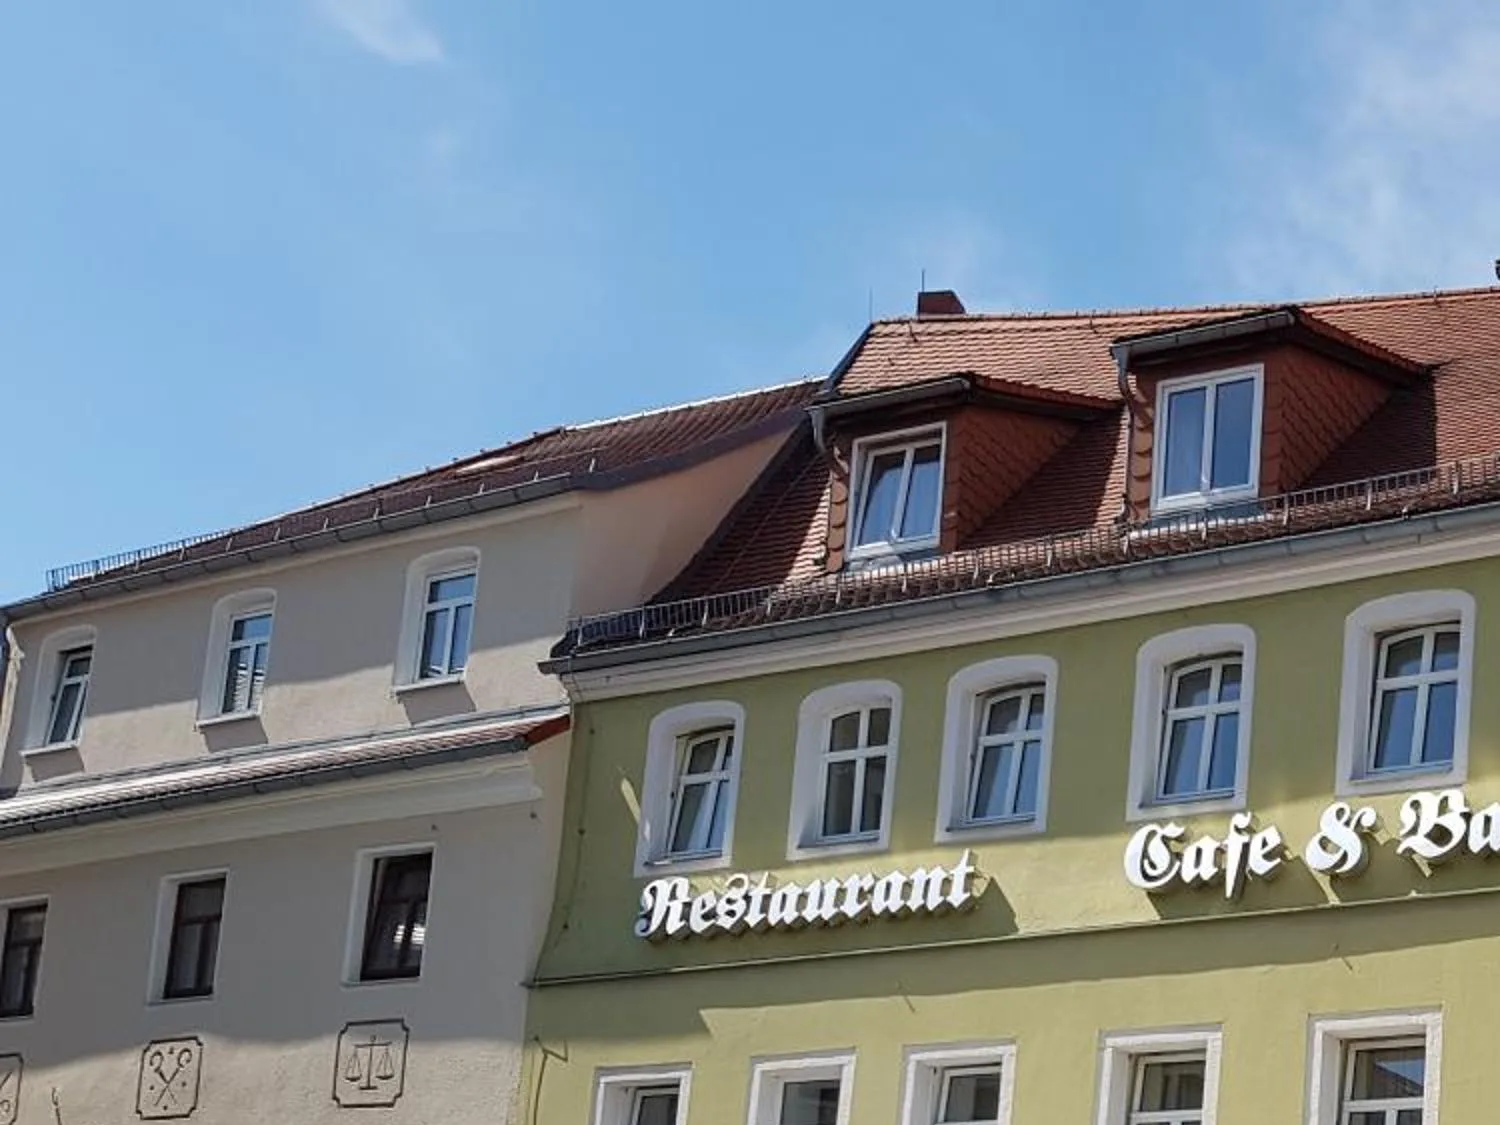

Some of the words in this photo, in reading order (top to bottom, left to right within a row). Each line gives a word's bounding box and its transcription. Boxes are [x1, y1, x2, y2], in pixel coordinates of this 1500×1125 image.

[634, 849, 975, 937] Restaurant
[1124, 811, 1282, 898] Cafe
[1306, 802, 1377, 873] &
